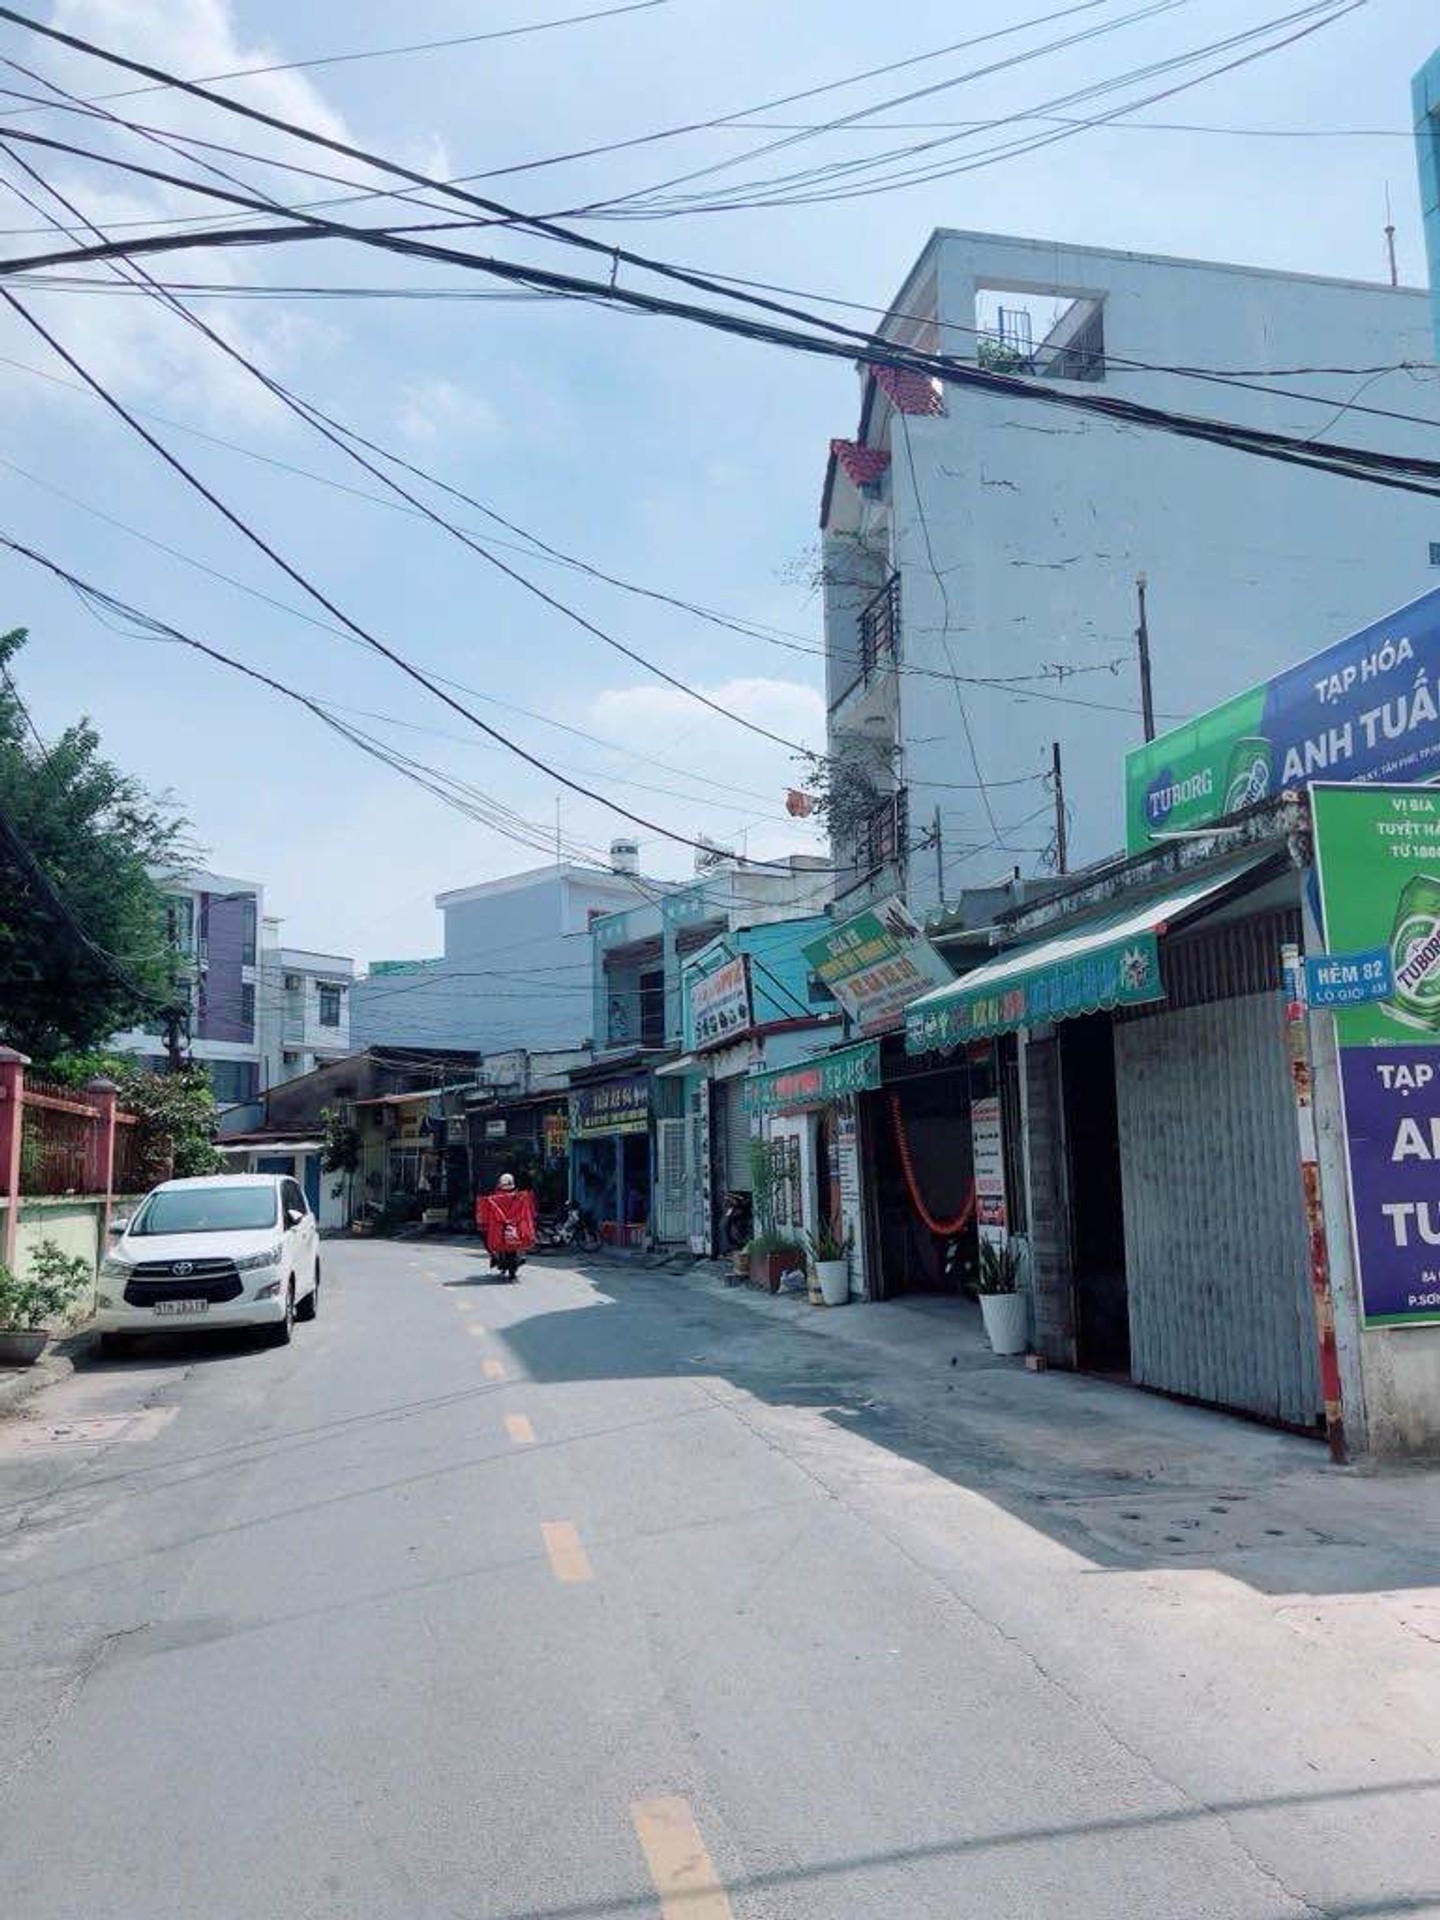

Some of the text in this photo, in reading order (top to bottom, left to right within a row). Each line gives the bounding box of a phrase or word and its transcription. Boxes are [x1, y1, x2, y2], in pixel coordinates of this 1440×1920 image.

[1314, 635, 1415, 706] TẠP HÓA
[1282, 665, 1440, 785] ANH TUẤ
[1149, 768, 1213, 818] TUBORG
[1392, 798, 1436, 817] VỊ BIA
[1317, 959, 1383, 986] HẺM 82
[1376, 1064, 1434, 1097] TẠP
